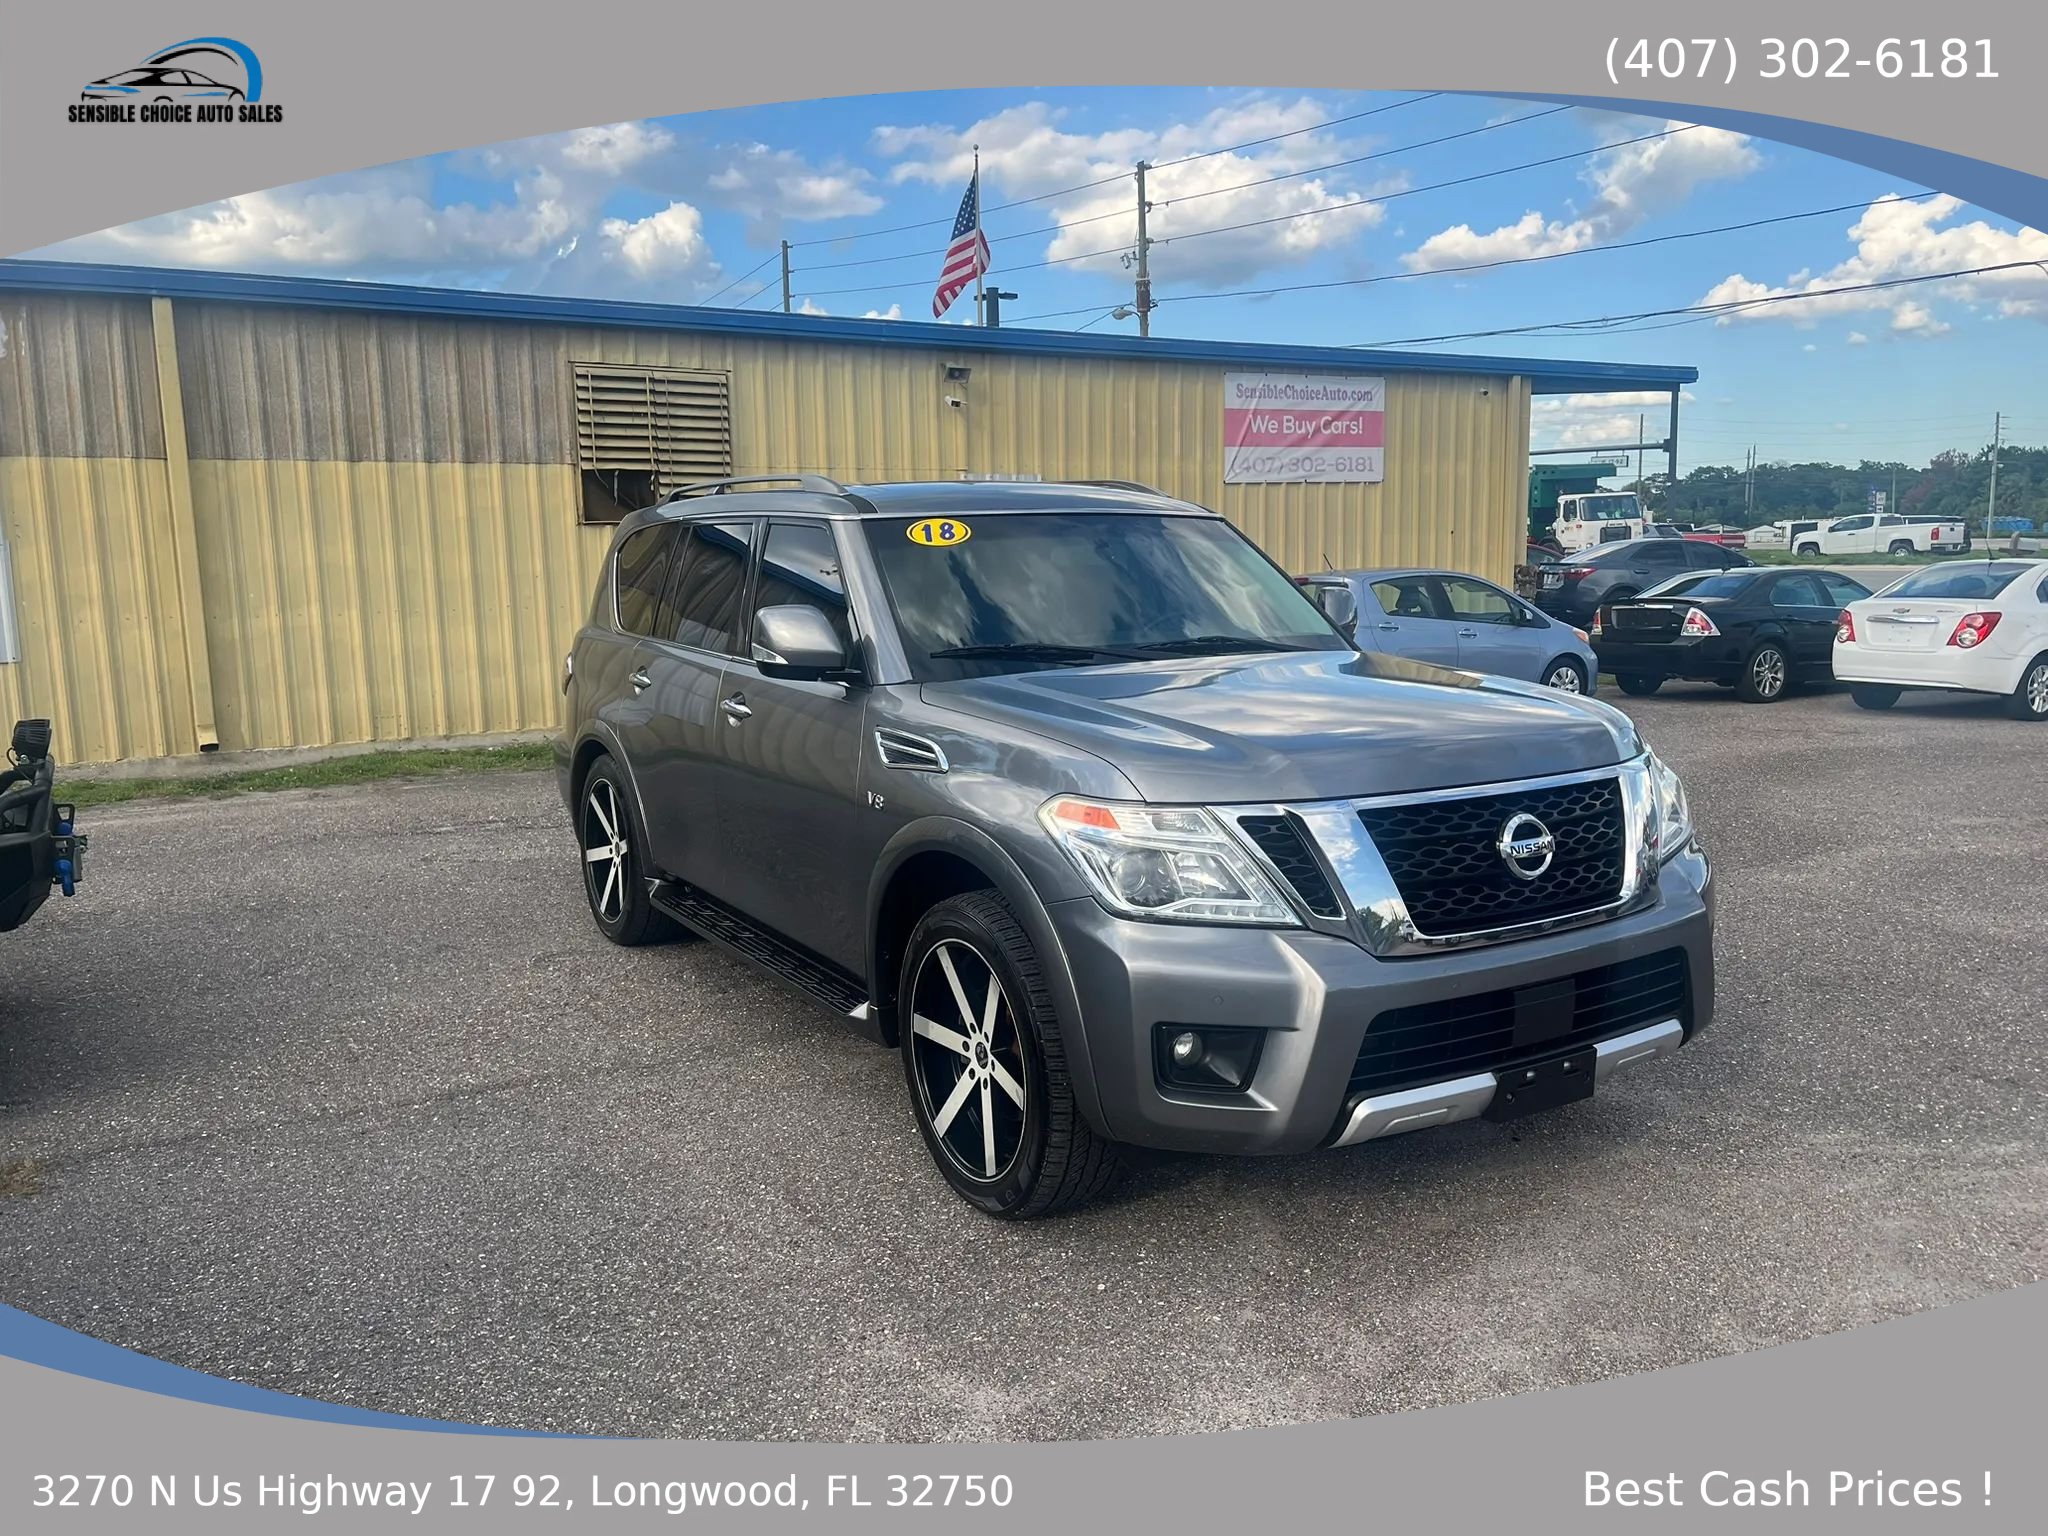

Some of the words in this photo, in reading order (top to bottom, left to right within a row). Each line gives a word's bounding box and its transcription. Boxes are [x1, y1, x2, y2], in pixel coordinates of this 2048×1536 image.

[1236, 383, 1373, 402] SensibleChoiceAuto.com
[1249, 415, 1278, 434] We
[1283, 415, 1315, 439] Buy
[1320, 415, 1363, 435] Cars!
[1231, 456, 1284, 475] (407)
[1288, 456, 1374, 473] 302-6181
[921, 522, 956, 543] 18
[867, 790, 884, 810] V8
[1510, 838, 1554, 855] NISSAN
